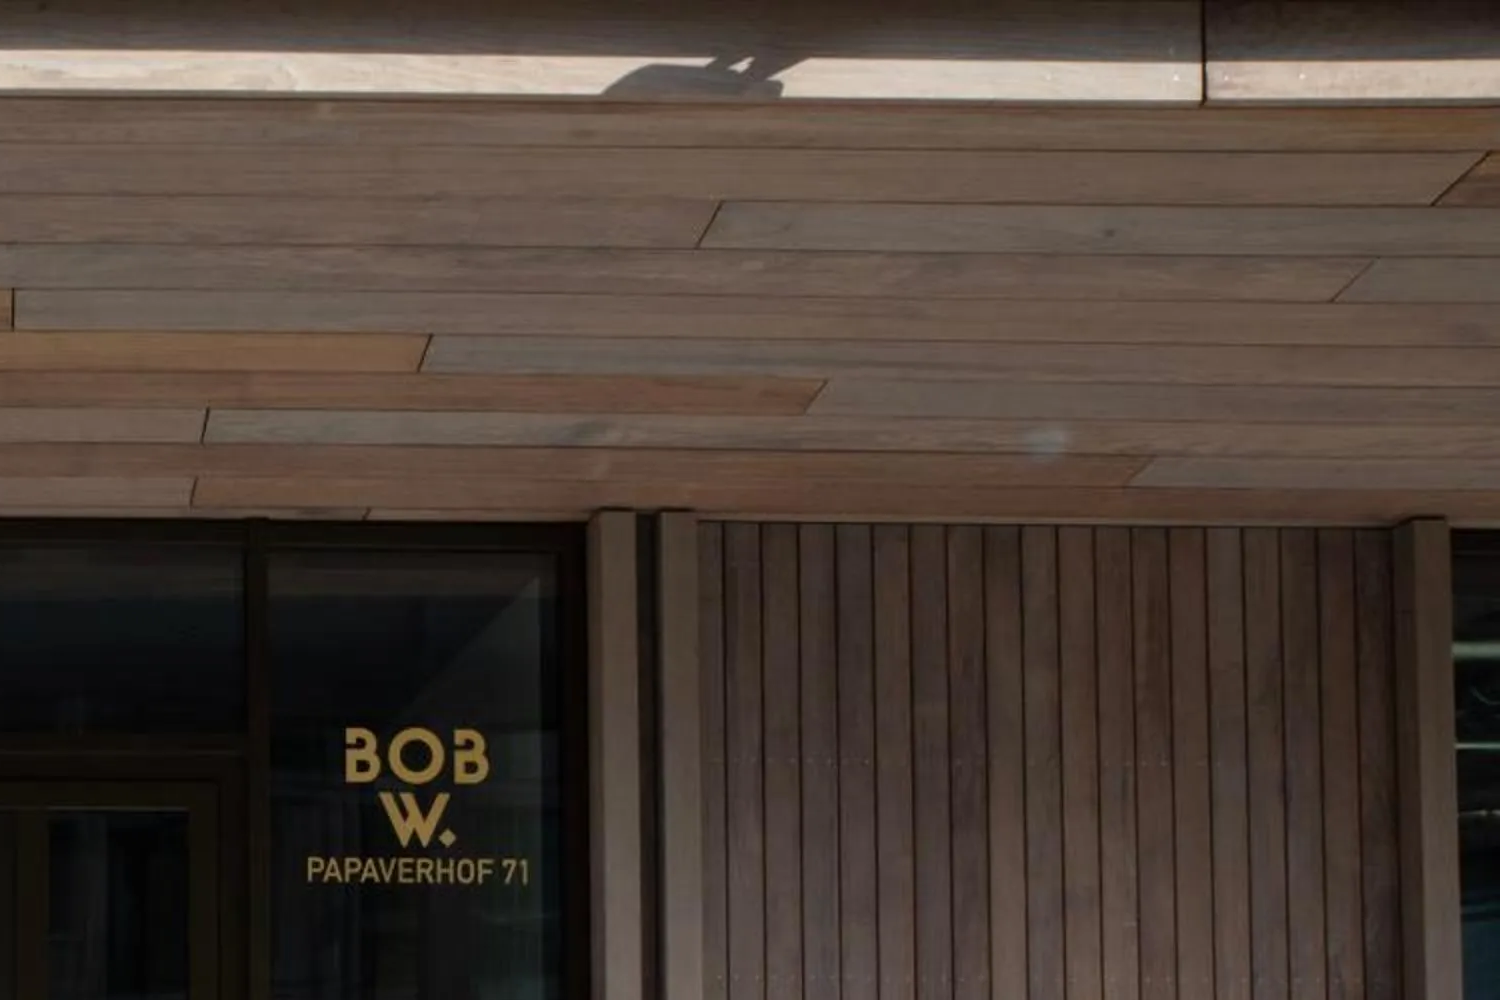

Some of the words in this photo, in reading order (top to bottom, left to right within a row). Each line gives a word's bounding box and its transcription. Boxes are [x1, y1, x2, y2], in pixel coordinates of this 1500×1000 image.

[345, 727, 490, 785] BOB
[378, 791, 457, 849] W.
[306, 855, 495, 884] PAPAVERHOF
[502, 858, 529, 886] 71
